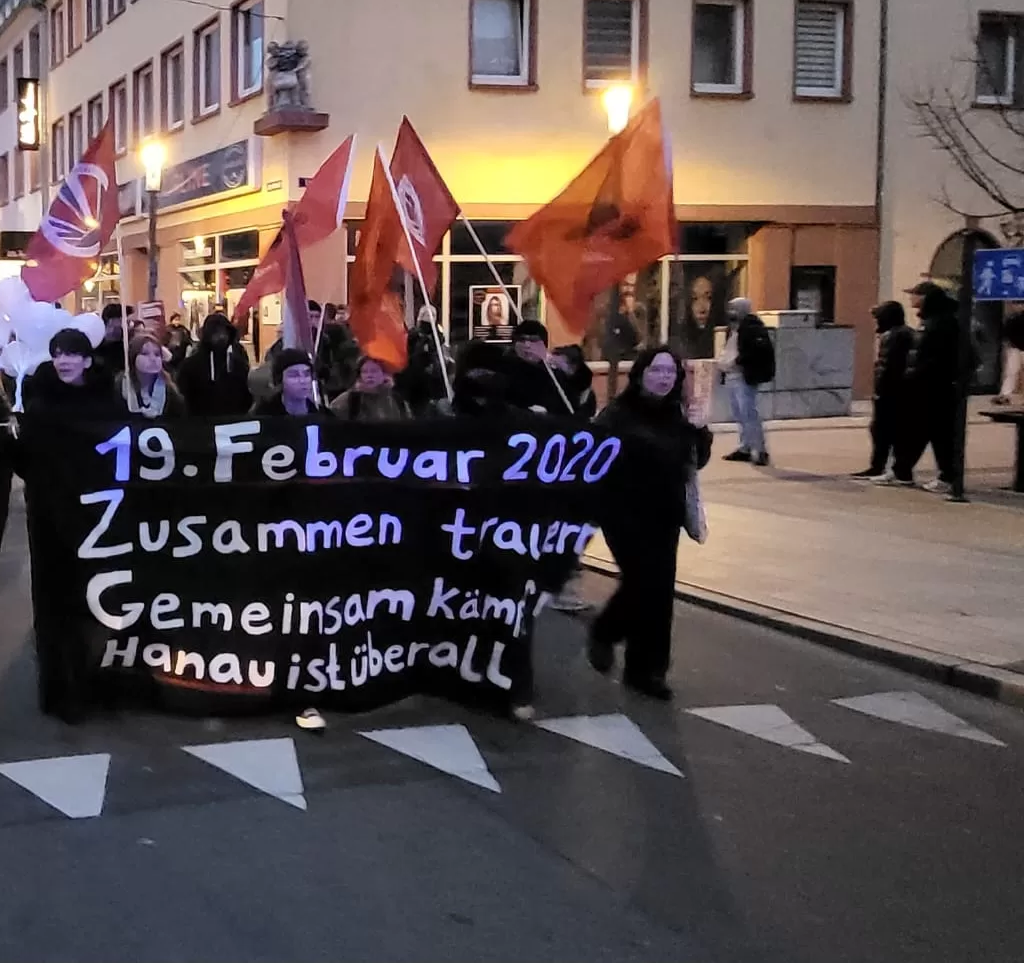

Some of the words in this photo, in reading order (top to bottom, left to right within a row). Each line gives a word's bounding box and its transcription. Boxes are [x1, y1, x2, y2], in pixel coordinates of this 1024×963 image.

[95, 426, 198, 482] 19.
[214, 421, 485, 483] Februar
[502, 431, 621, 484] 2020
[78, 489, 403, 559] Zusammen
[86, 570, 416, 636] Gemeinsam
[101, 637, 276, 688] Hanau
[287, 643, 346, 693] ist
[351, 631, 513, 691] überall
